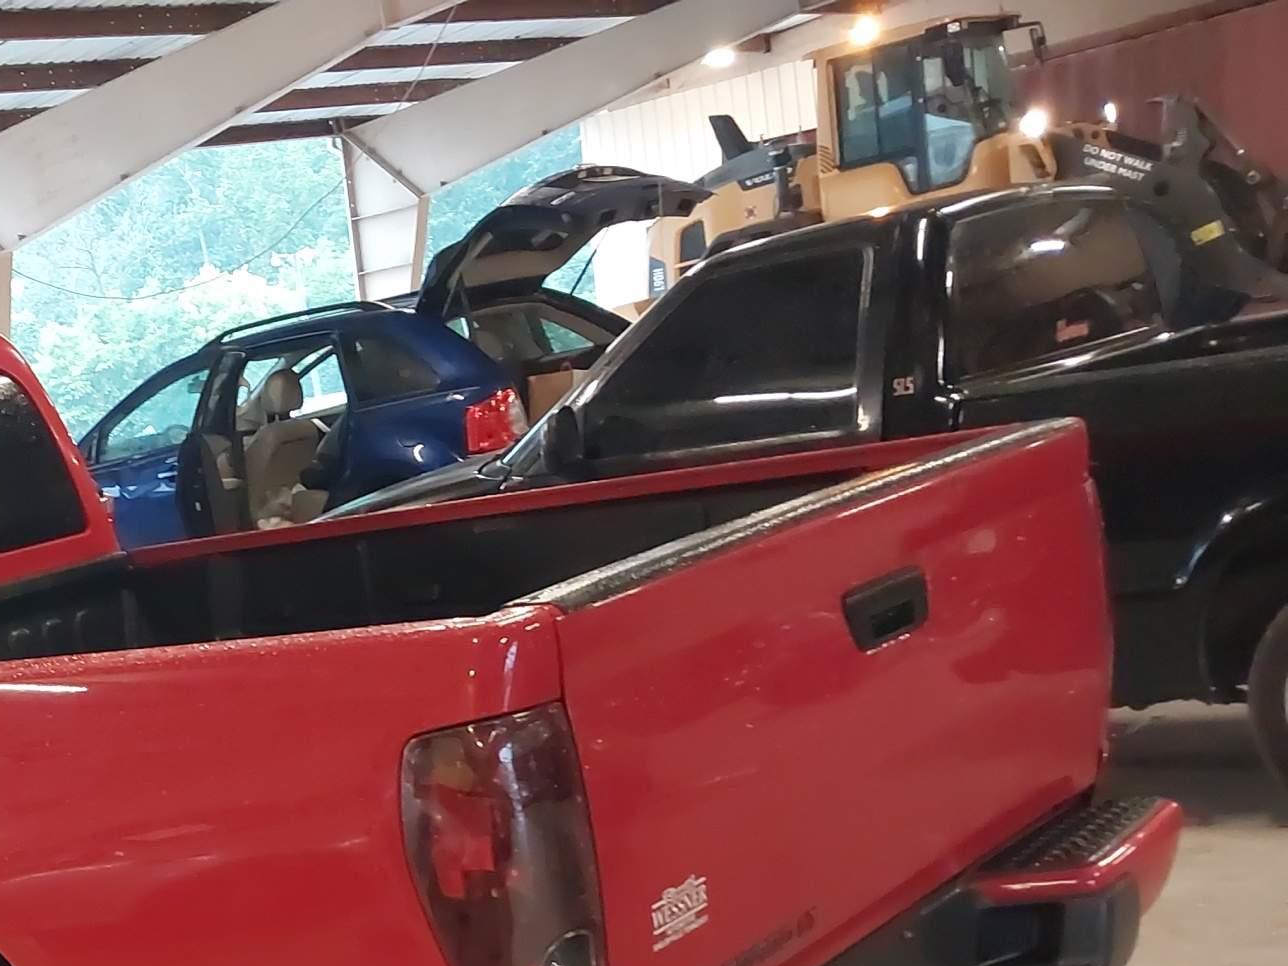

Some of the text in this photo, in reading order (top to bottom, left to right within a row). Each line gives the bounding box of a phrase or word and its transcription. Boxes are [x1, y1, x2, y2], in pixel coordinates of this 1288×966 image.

[1082, 143, 1153, 171] DO NOT WALK
[1083, 156, 1145, 181] UNDER MAST
